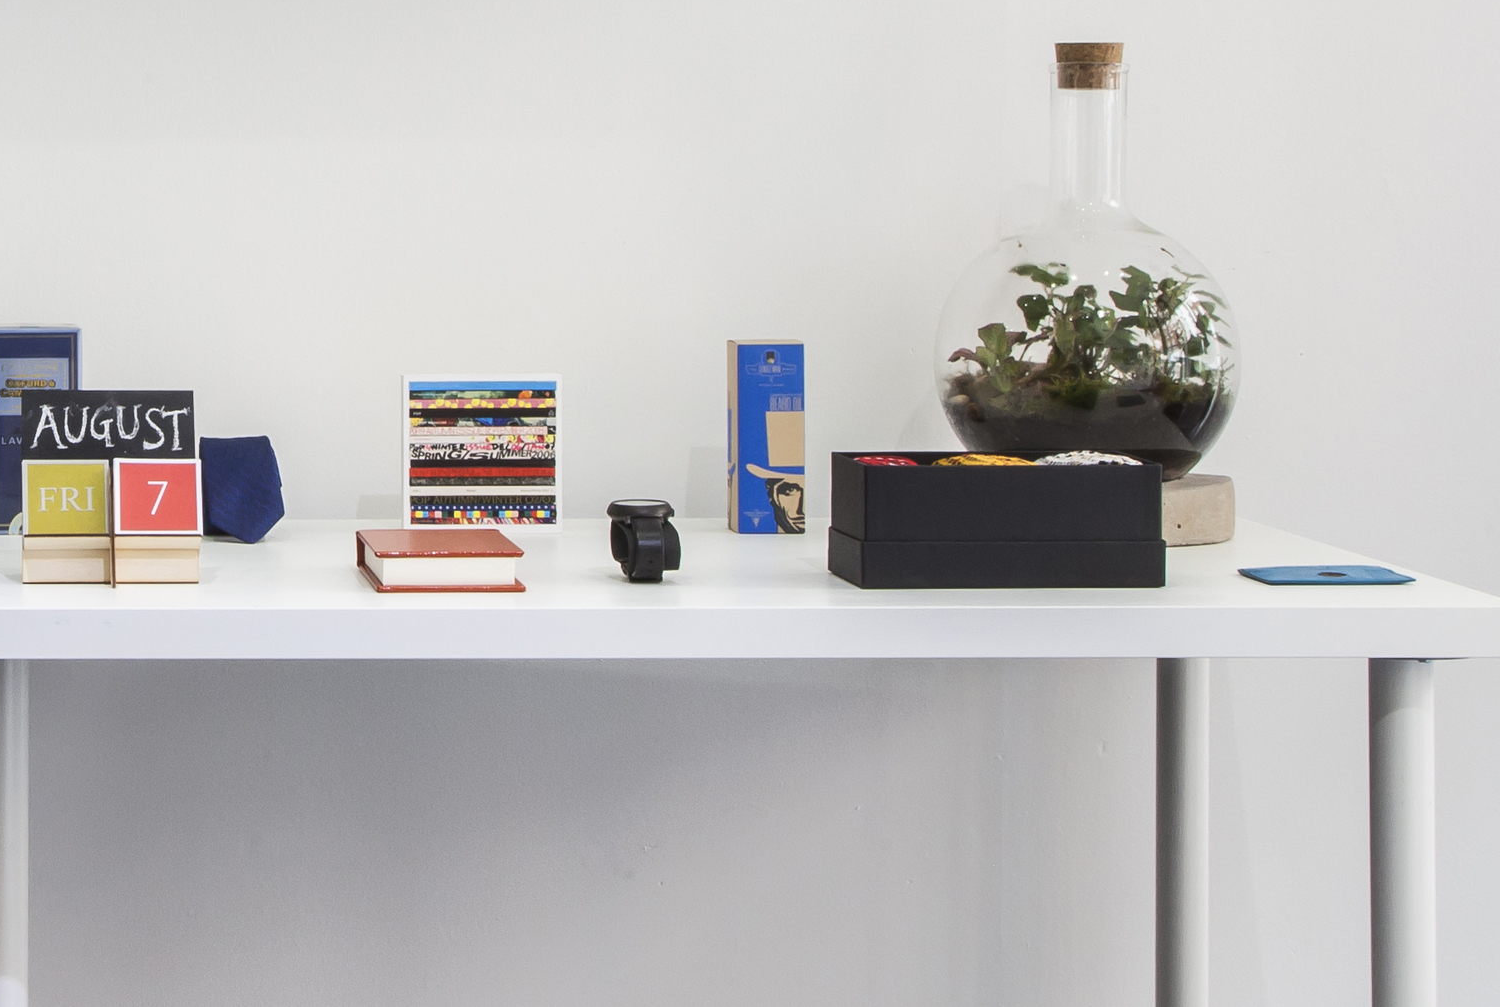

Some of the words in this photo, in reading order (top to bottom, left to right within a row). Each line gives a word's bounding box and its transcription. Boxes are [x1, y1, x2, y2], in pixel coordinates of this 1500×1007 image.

[29, 404, 192, 451] AUGUST
[37, 485, 97, 513] FRI
[146, 480, 169, 516] 7
